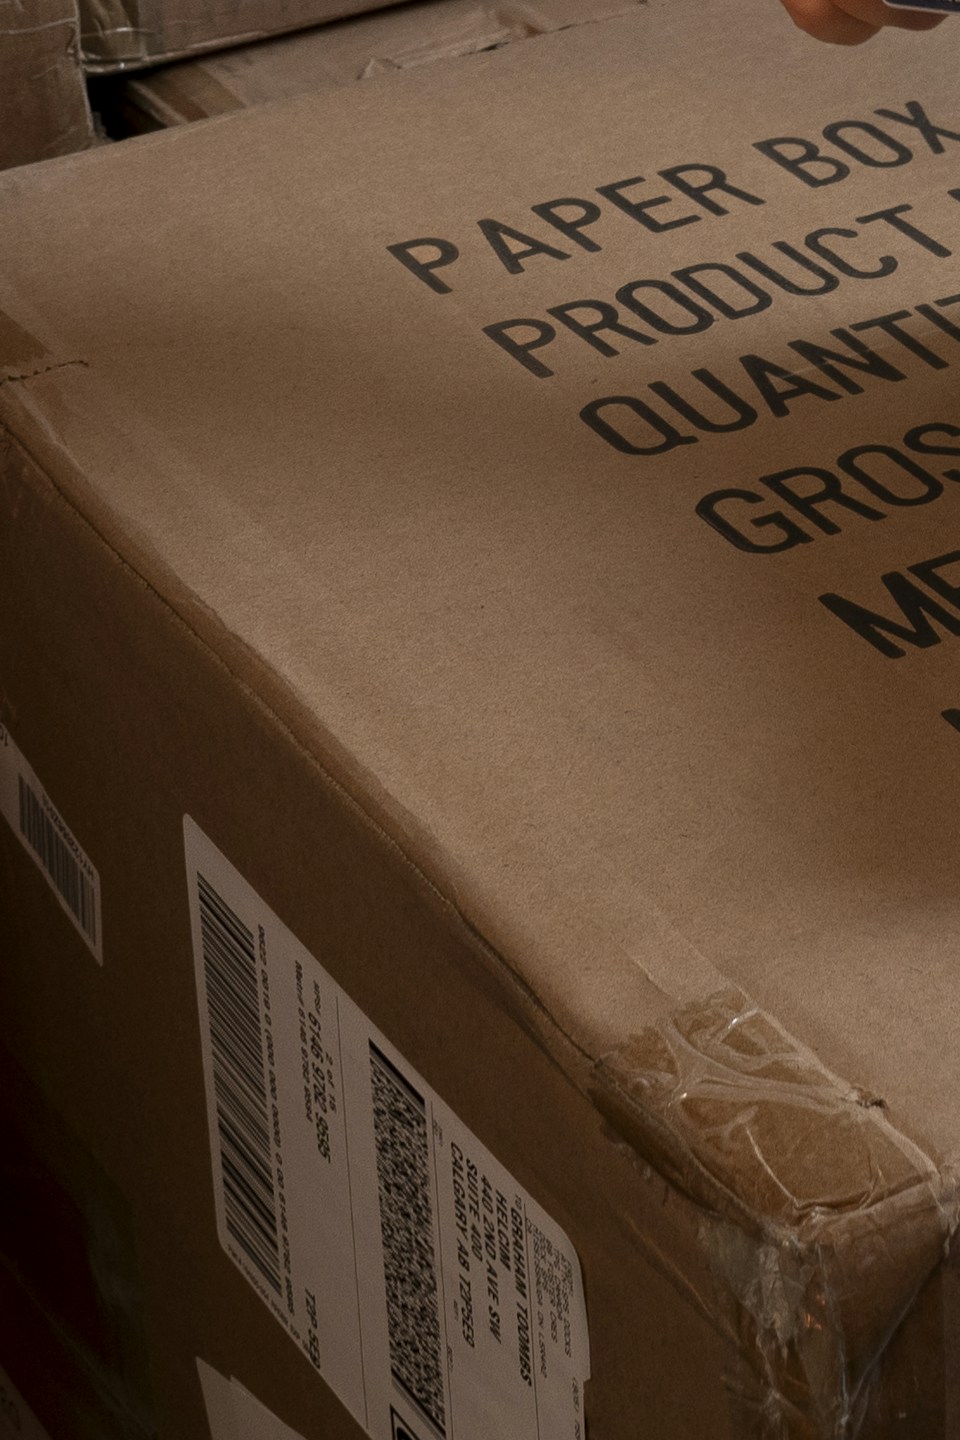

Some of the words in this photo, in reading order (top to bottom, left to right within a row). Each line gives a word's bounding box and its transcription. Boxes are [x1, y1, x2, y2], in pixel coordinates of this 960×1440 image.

[387, 163, 766, 295] PAPER
[481, 204, 953, 379] PRODUCT
[309, 1011, 322, 1063] 6146
[312, 1061, 325, 1114] 9782
[316, 1111, 329, 1163] 9595
[451, 1140, 466, 1239] CALGARY
[466, 1157, 478, 1221] SUITE
[481, 1173, 491, 1213] 440
[458, 1239, 468, 1271] AB
[471, 1221, 481, 1261] 400
[483, 1214, 494, 1260] 2ND
[496, 1189, 509, 1271] HELCIM
[511, 1205, 526, 1299] GRAHAM
[305, 1286, 316, 1329] T2P
[486, 1260, 497, 1304] AVE
[459, 1271, 473, 1347] T2P5E9
[489, 1304, 499, 1342] SW
[516, 1299, 531, 1388] TOOMBS
